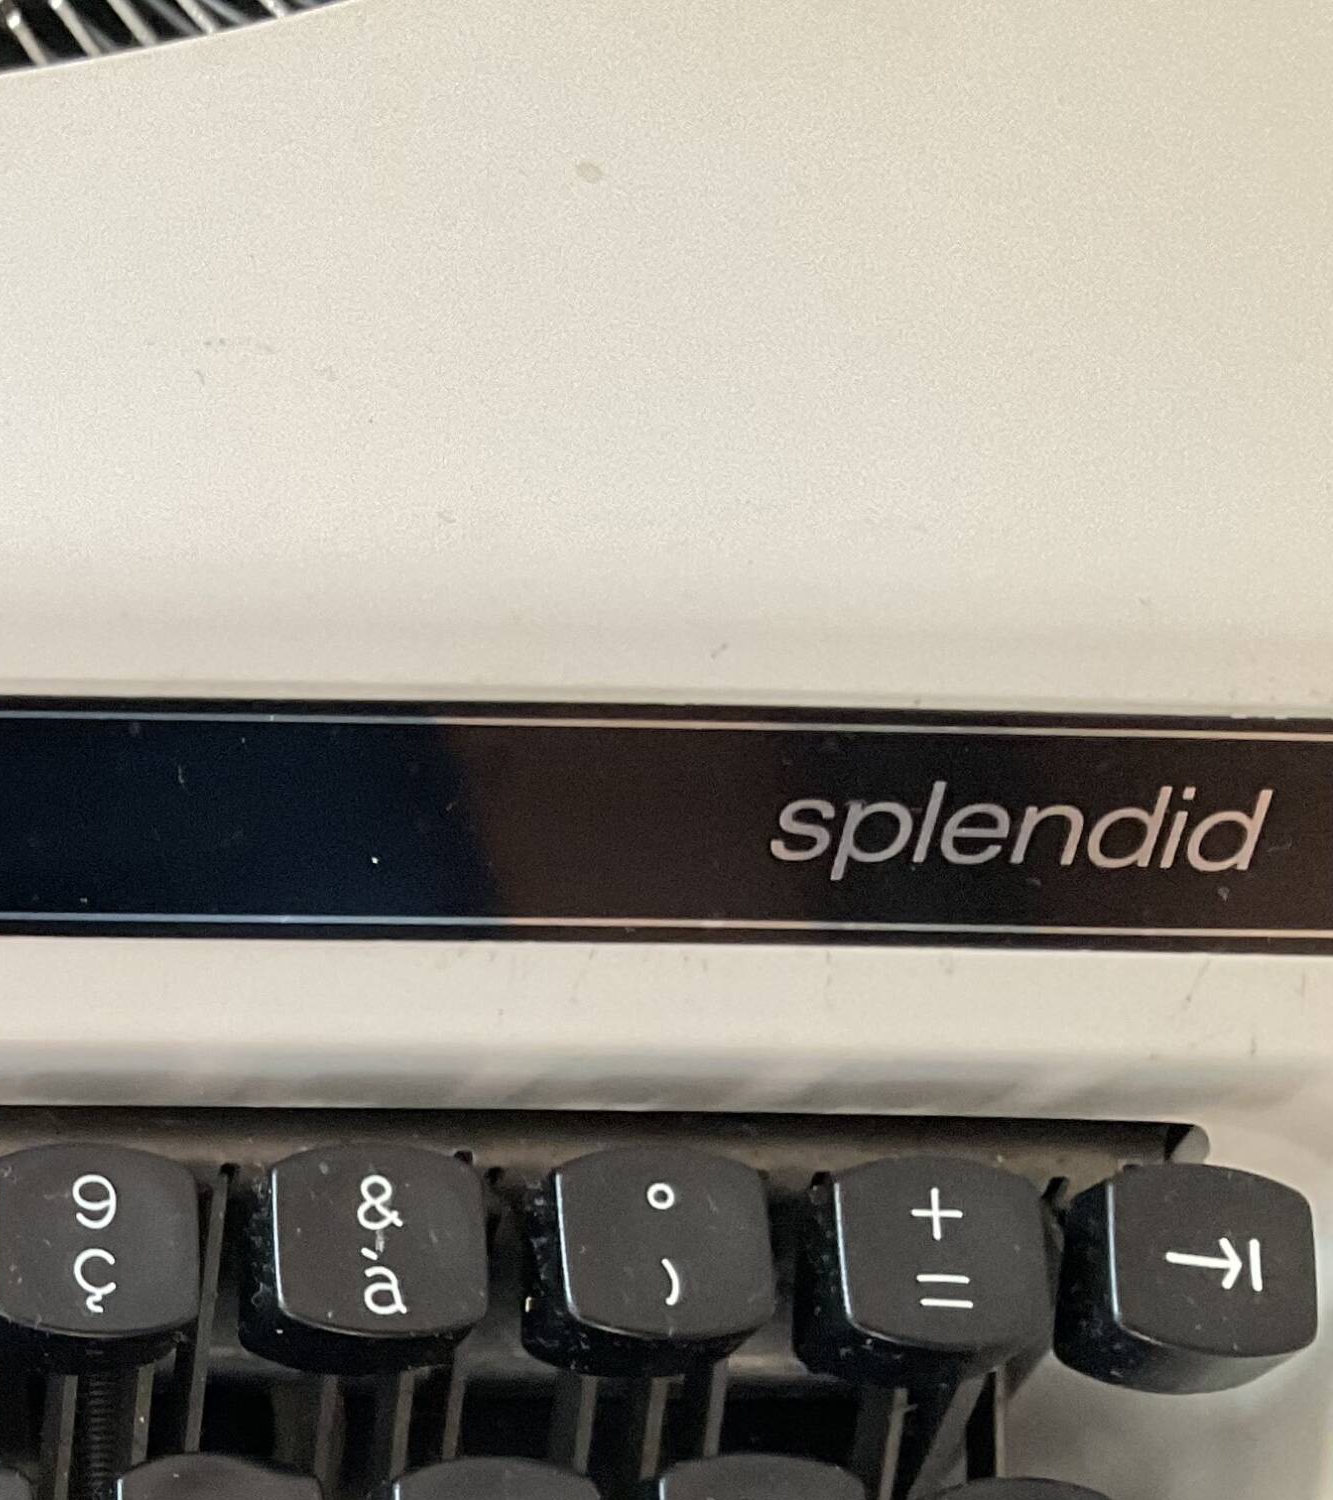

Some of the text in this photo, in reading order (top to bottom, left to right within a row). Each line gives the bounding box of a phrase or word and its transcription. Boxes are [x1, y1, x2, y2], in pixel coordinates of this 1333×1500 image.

[769, 781, 1274, 881] splendid
[72, 1174, 117, 1229] 9
[357, 1174, 404, 1231] &
[911, 1187, 963, 1241] +
[73, 1248, 117, 1313] ç
[360, 1247, 408, 1315] à
[661, 1258, 680, 1306] )
[916, 1274, 974, 1309] =
